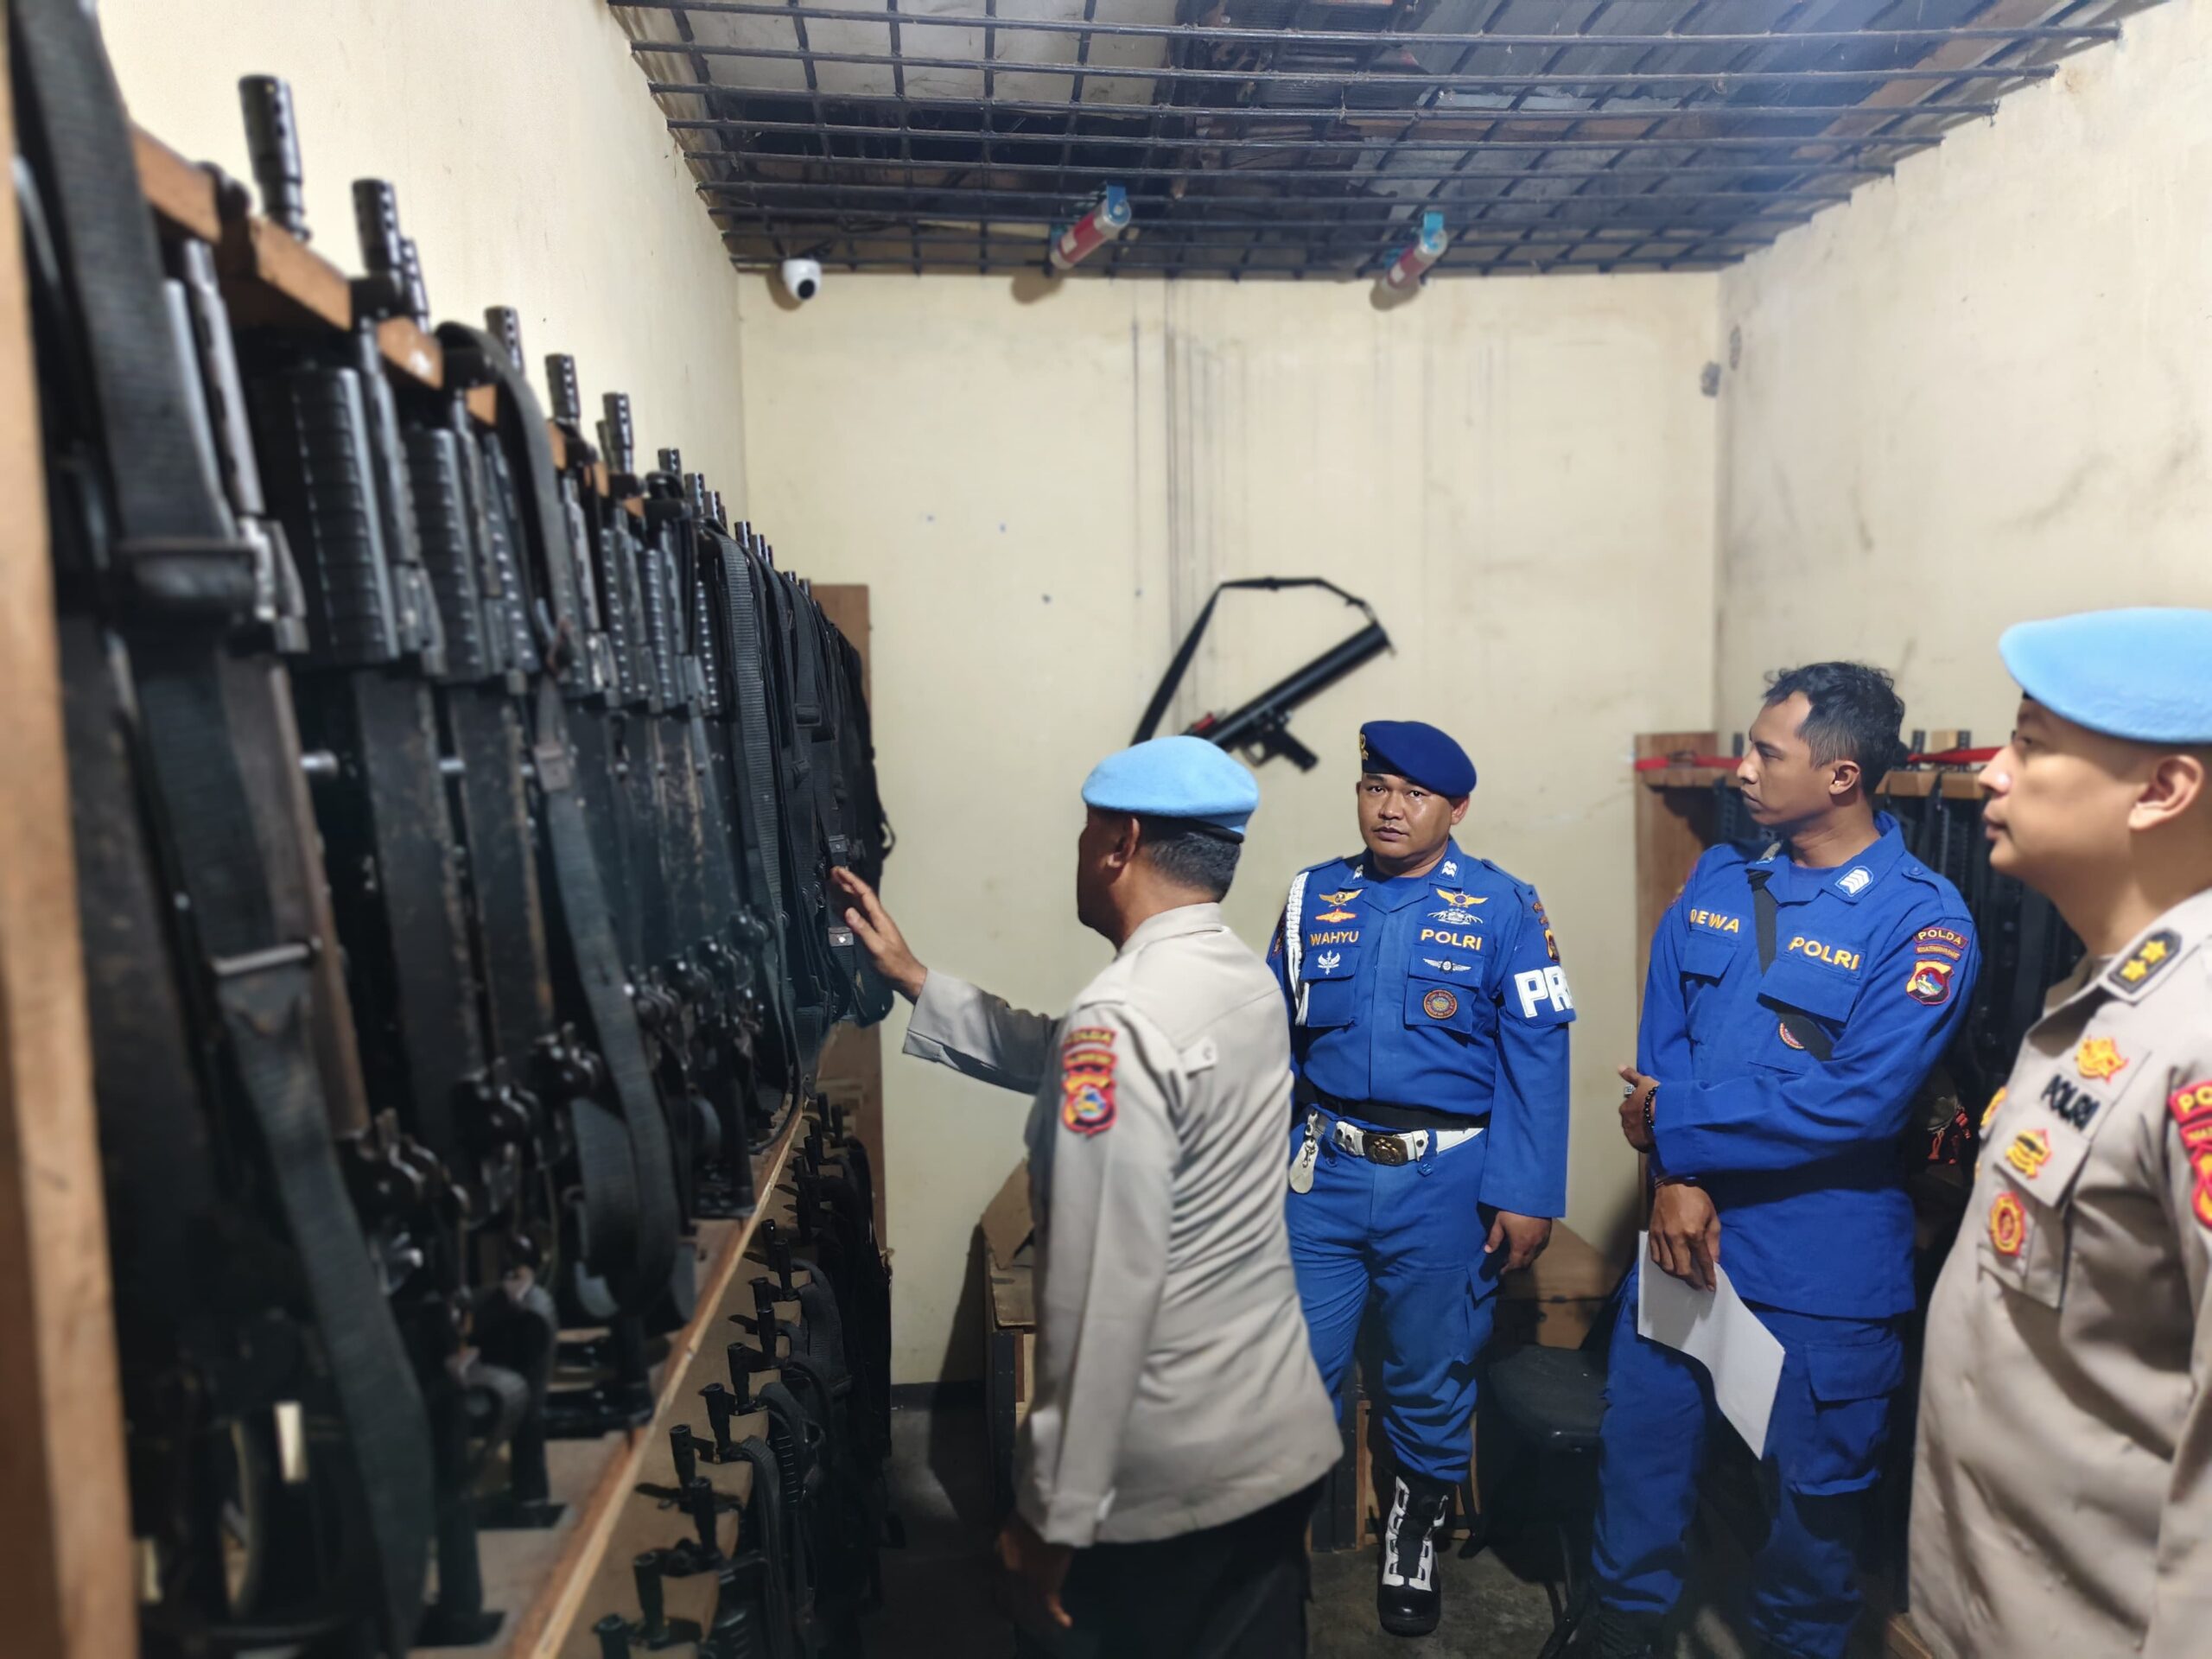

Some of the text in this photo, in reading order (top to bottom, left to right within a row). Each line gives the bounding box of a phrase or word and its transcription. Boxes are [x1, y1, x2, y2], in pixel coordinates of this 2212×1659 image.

[1310, 930, 1359, 946] WAHYU
[1421, 929, 1482, 950] POLRI
[1918, 930, 1961, 945] POLDA
[1789, 936, 1860, 969] POLRI
